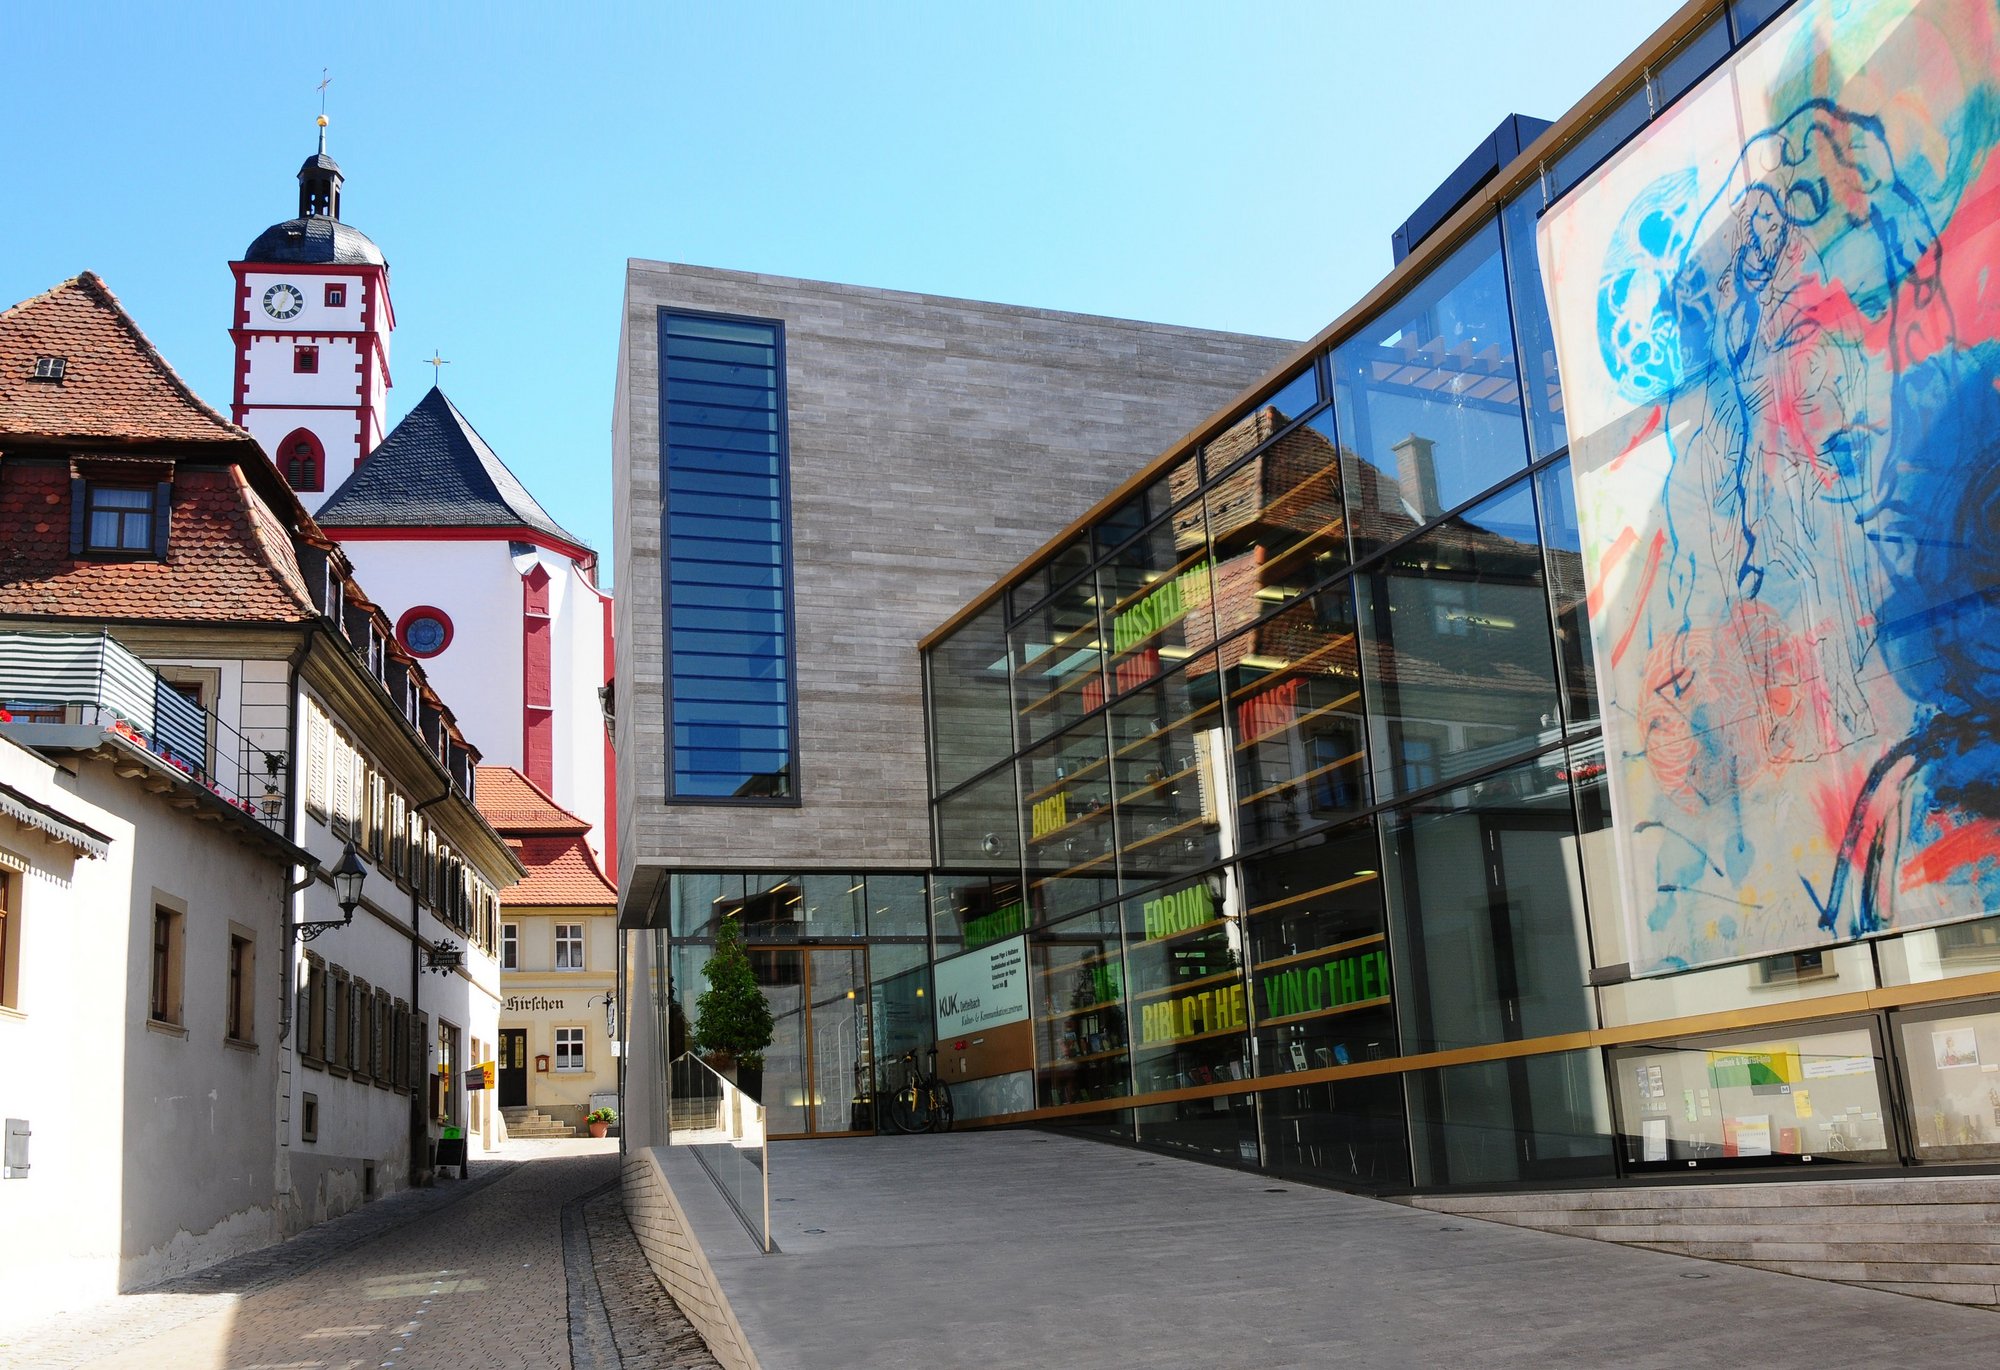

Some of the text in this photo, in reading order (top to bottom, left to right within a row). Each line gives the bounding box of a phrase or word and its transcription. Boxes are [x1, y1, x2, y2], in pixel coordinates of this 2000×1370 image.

[1238, 678, 1299, 743] KUNST
[1033, 791, 1066, 838] BUCH
[1144, 884, 1205, 941] FORUM
[504, 996, 564, 1012] Hirschen
